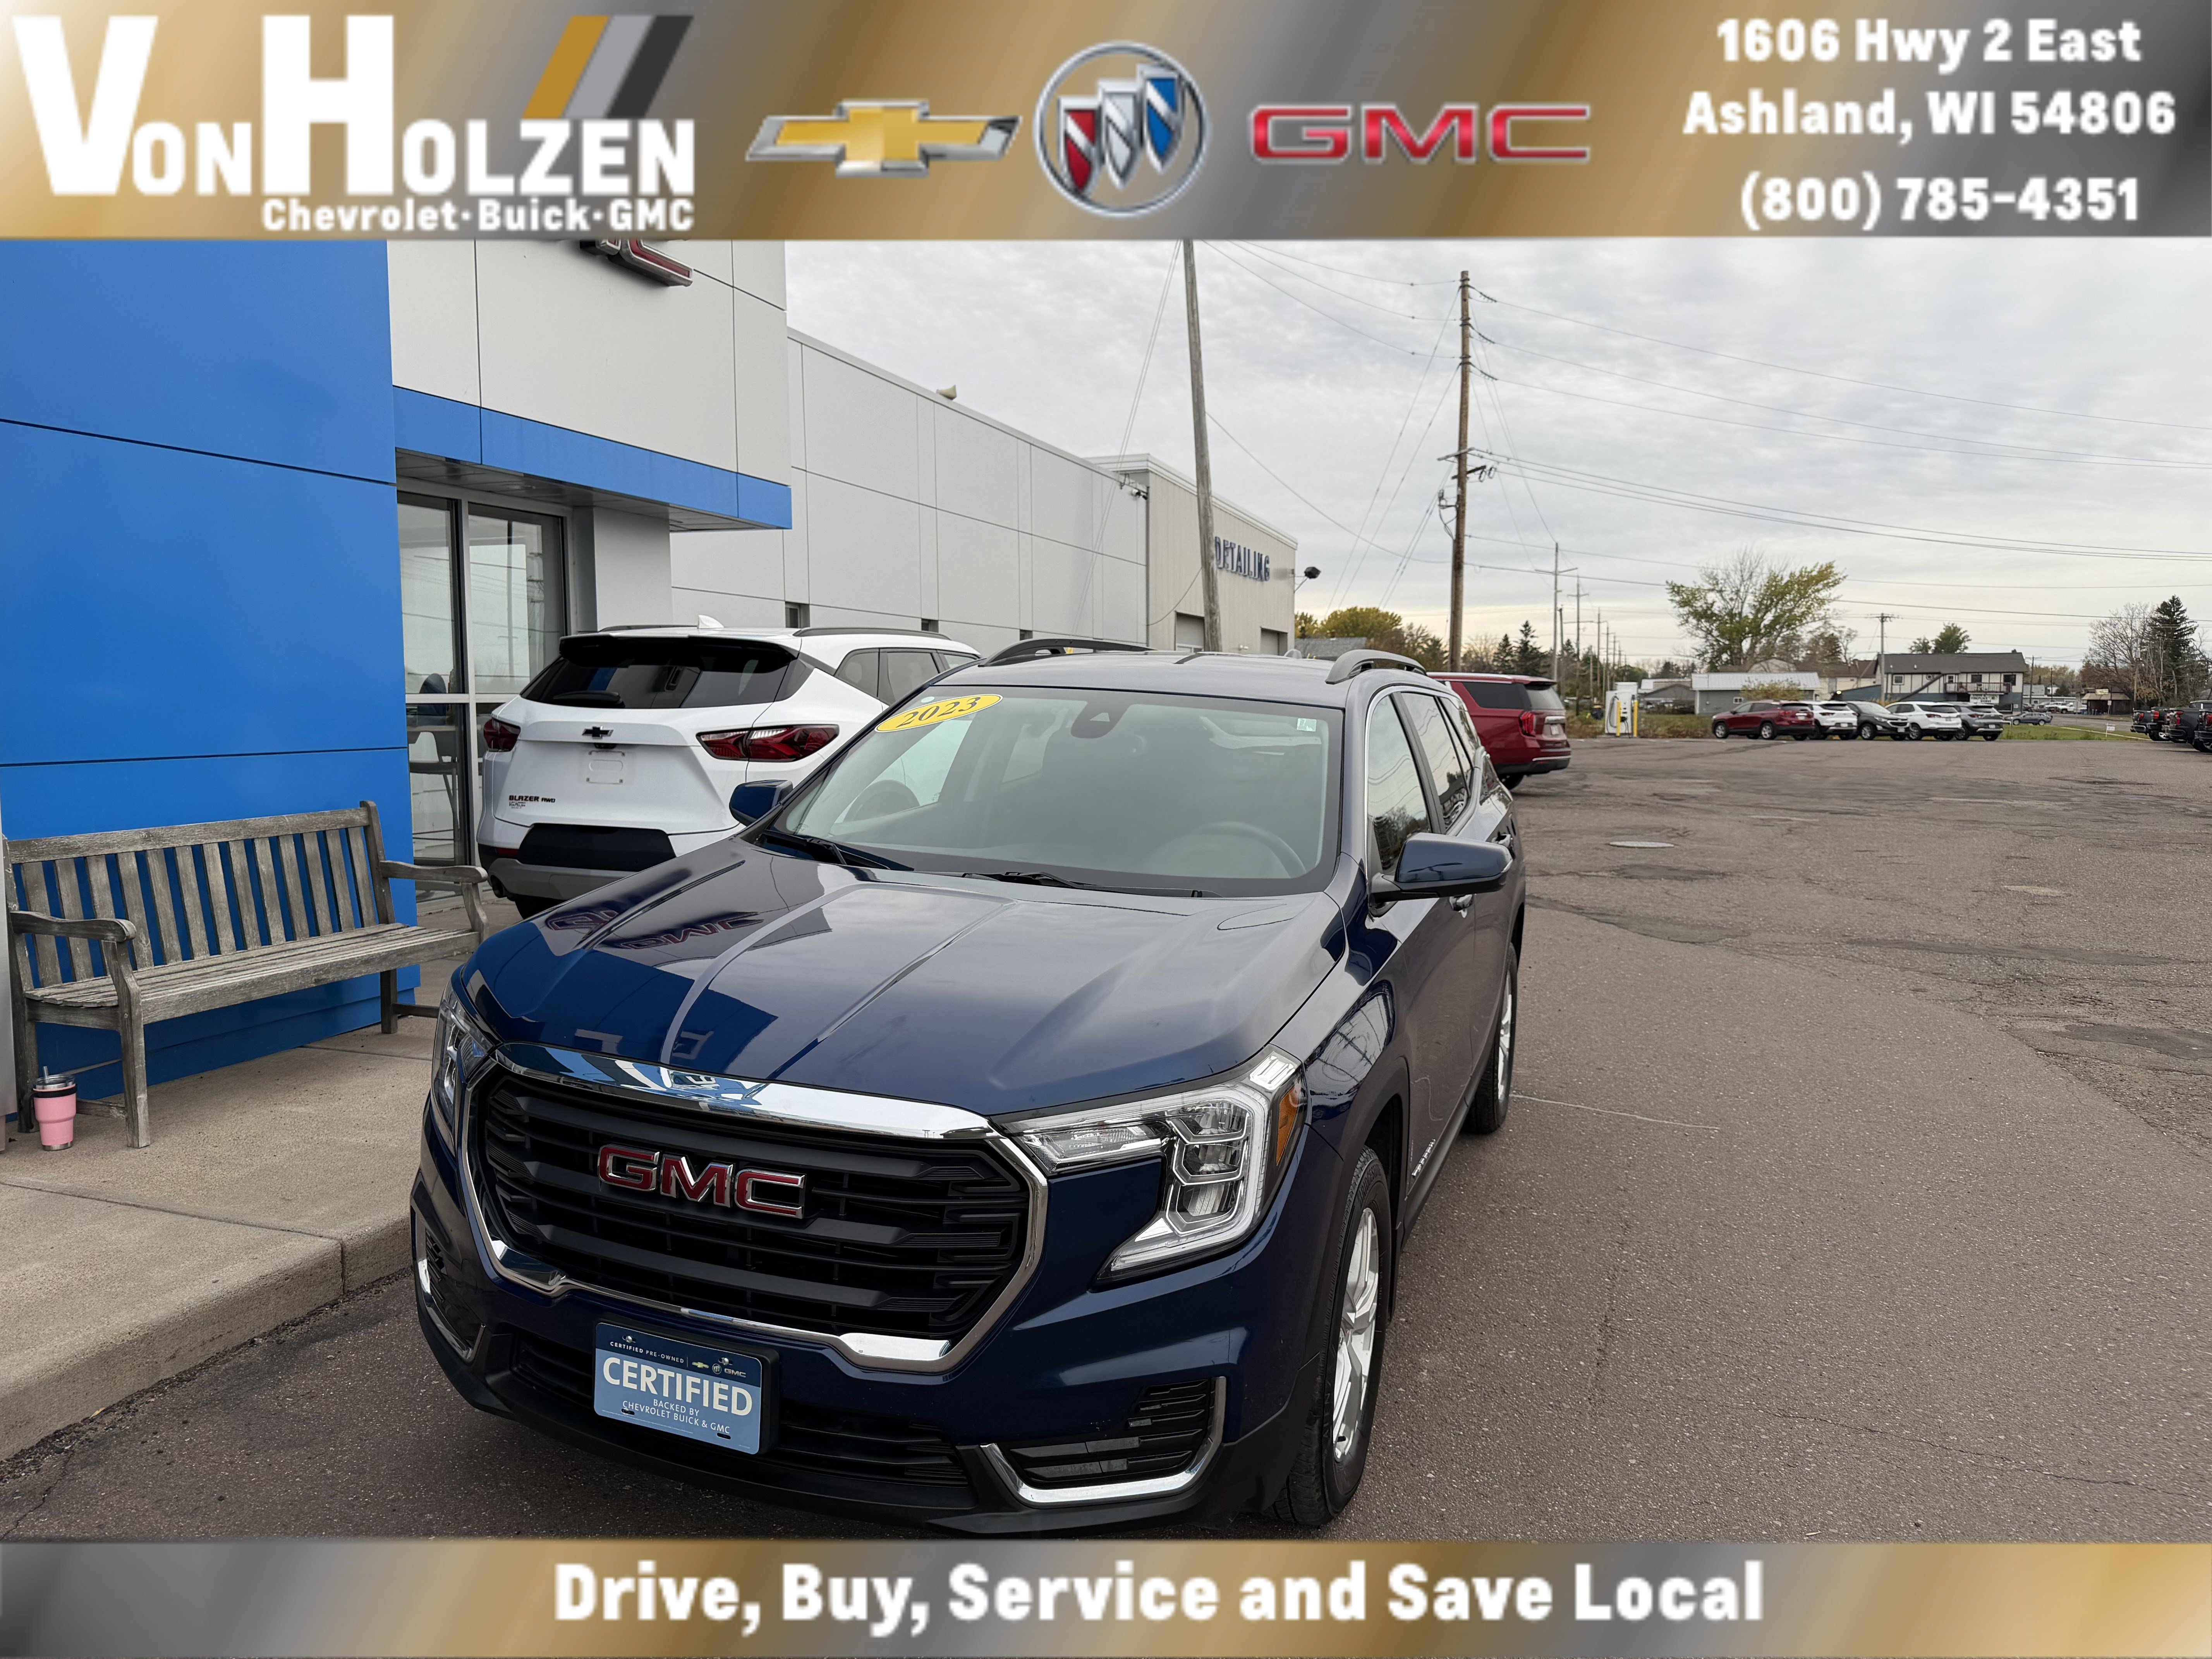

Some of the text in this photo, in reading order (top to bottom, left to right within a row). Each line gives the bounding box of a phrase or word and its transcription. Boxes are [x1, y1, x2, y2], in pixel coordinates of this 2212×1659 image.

[1215, 536, 1270, 582] DETAILING
[895, 697, 981, 728] 2023
[598, 1143, 805, 1219] GMC
[610, 1341, 684, 1364] CERTIFIED PRE-OWNED
[603, 1357, 752, 1416] CERTIFIED
[724, 1367, 746, 1378] GMC
[622, 1400, 730, 1434] CHEVROLET BUICK & GMC
[653, 1399, 699, 1416] BACKED BY
